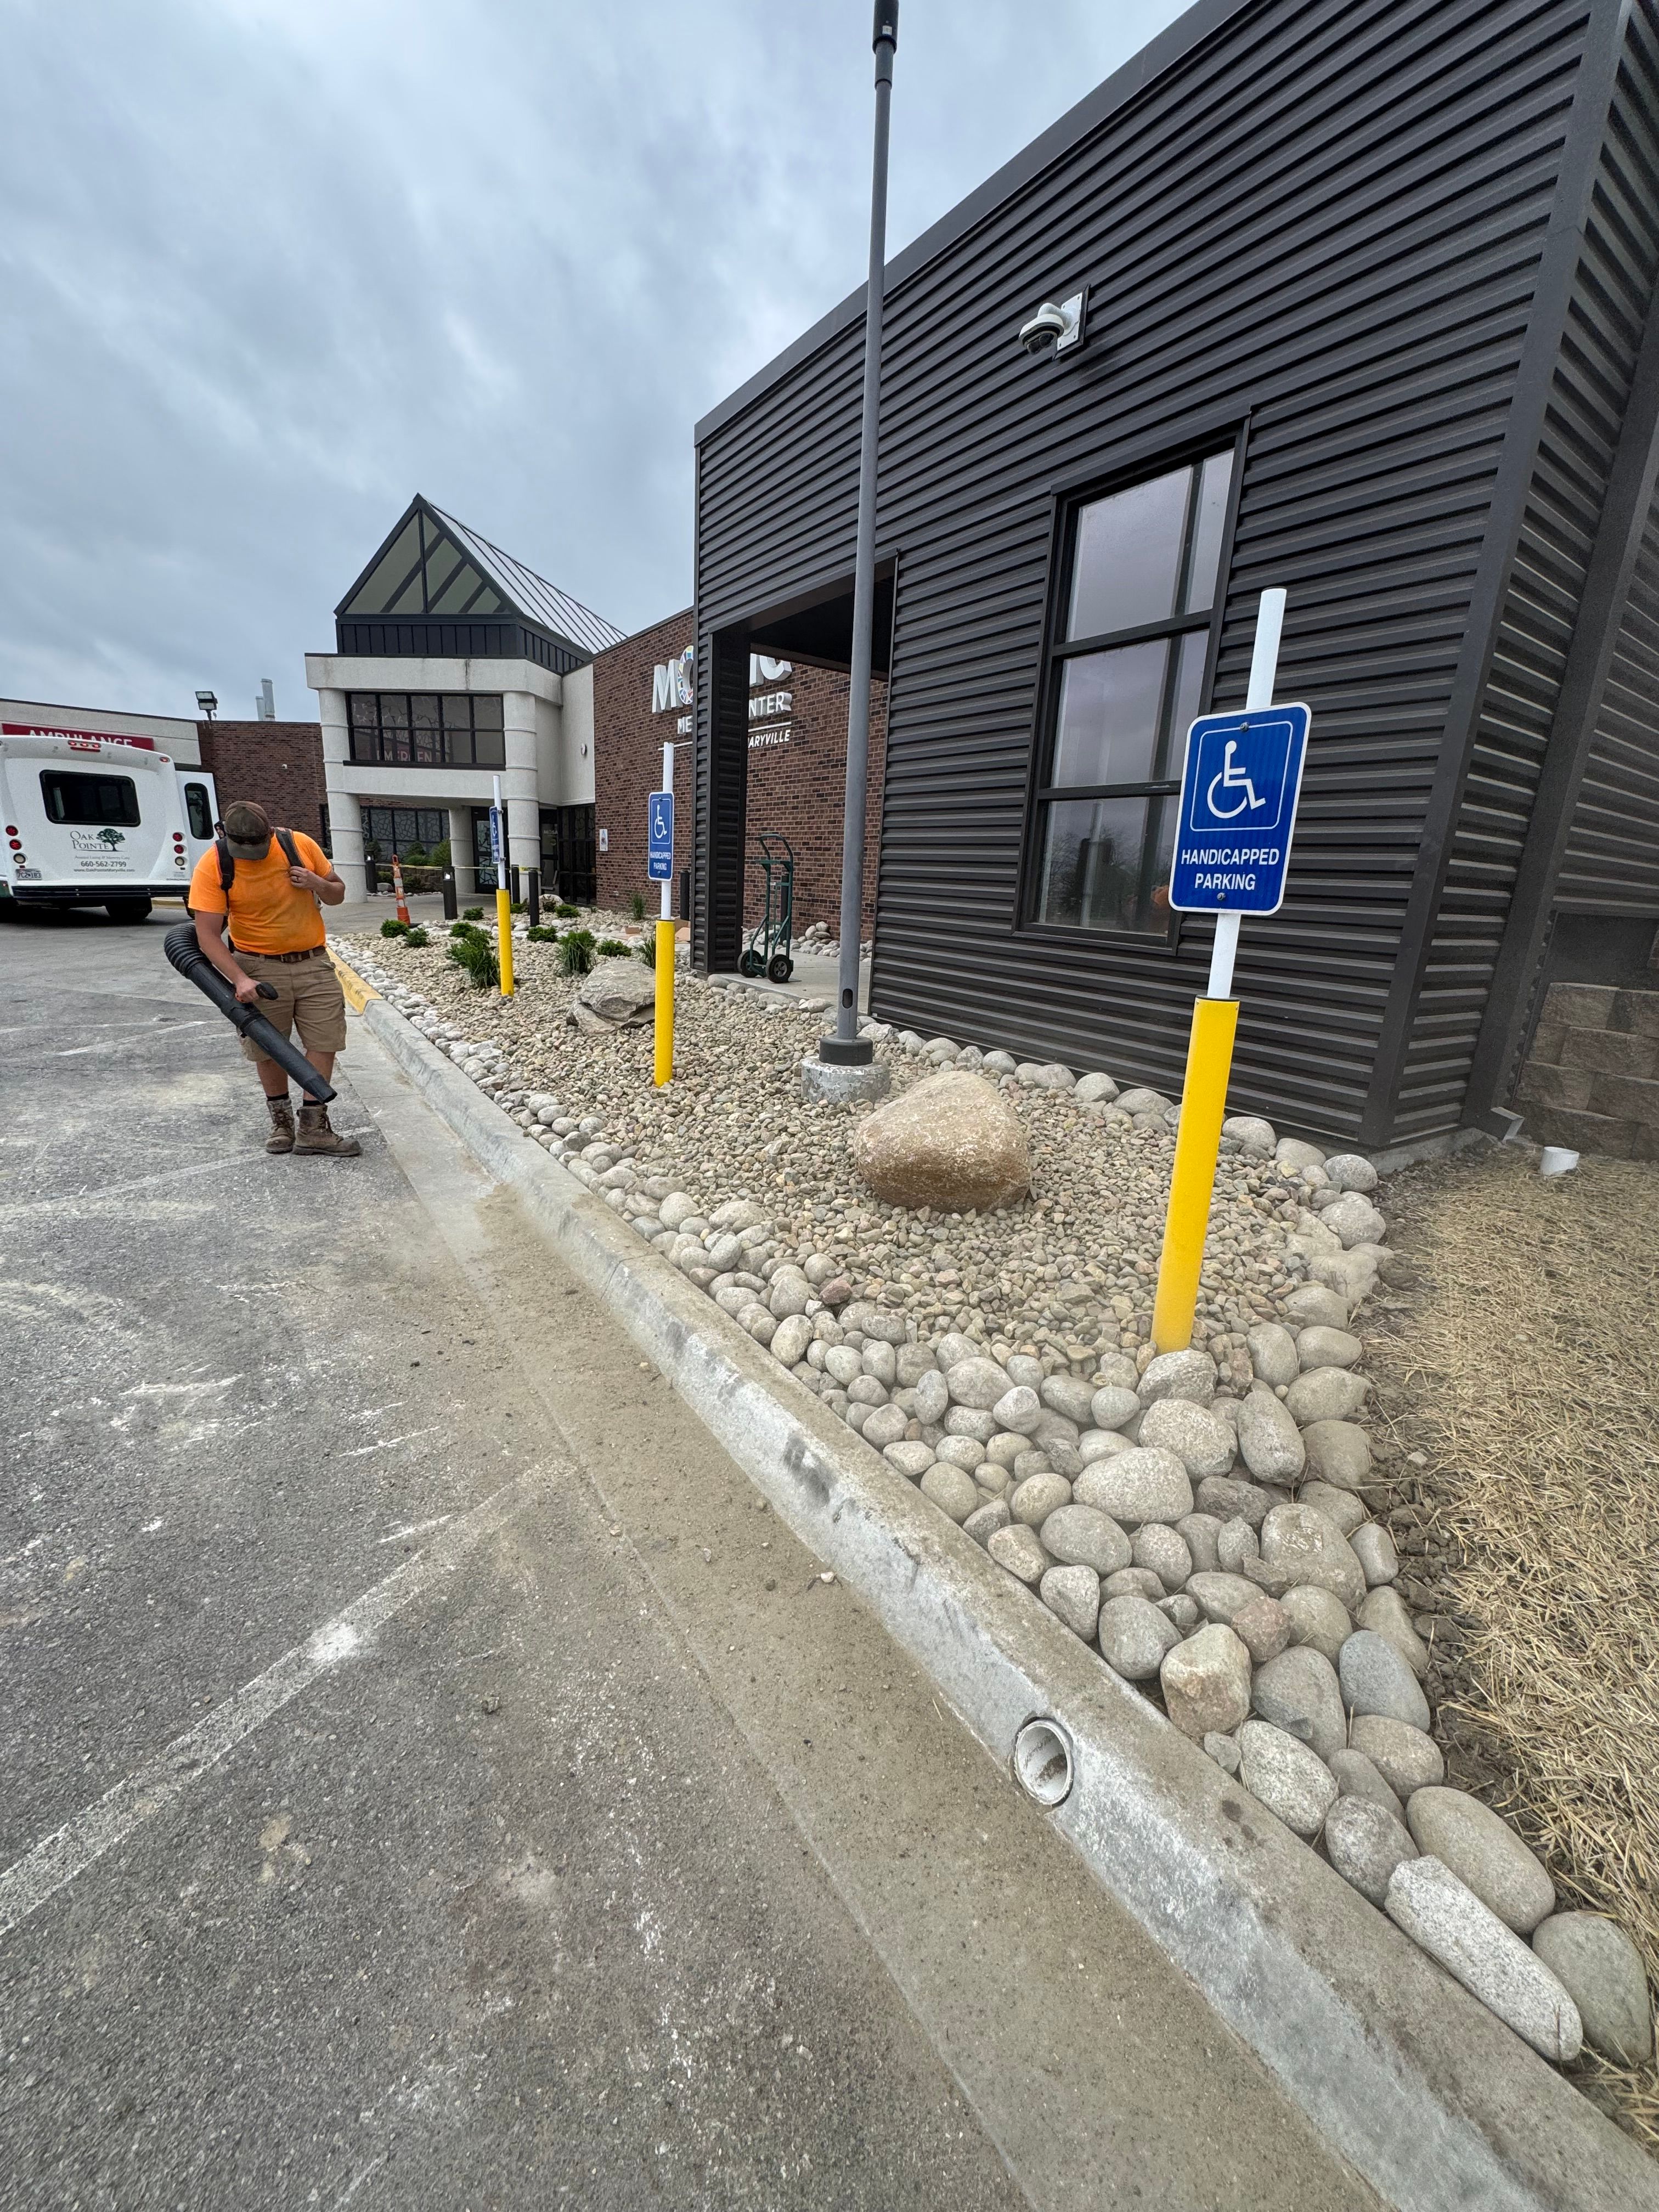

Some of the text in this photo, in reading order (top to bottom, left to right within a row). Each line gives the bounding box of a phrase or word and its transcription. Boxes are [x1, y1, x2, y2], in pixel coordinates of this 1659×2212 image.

[748, 692, 792, 720] NTER
[1181, 848, 1279, 865] HANDICAPPED
[1194, 873, 1256, 890] PARKING
